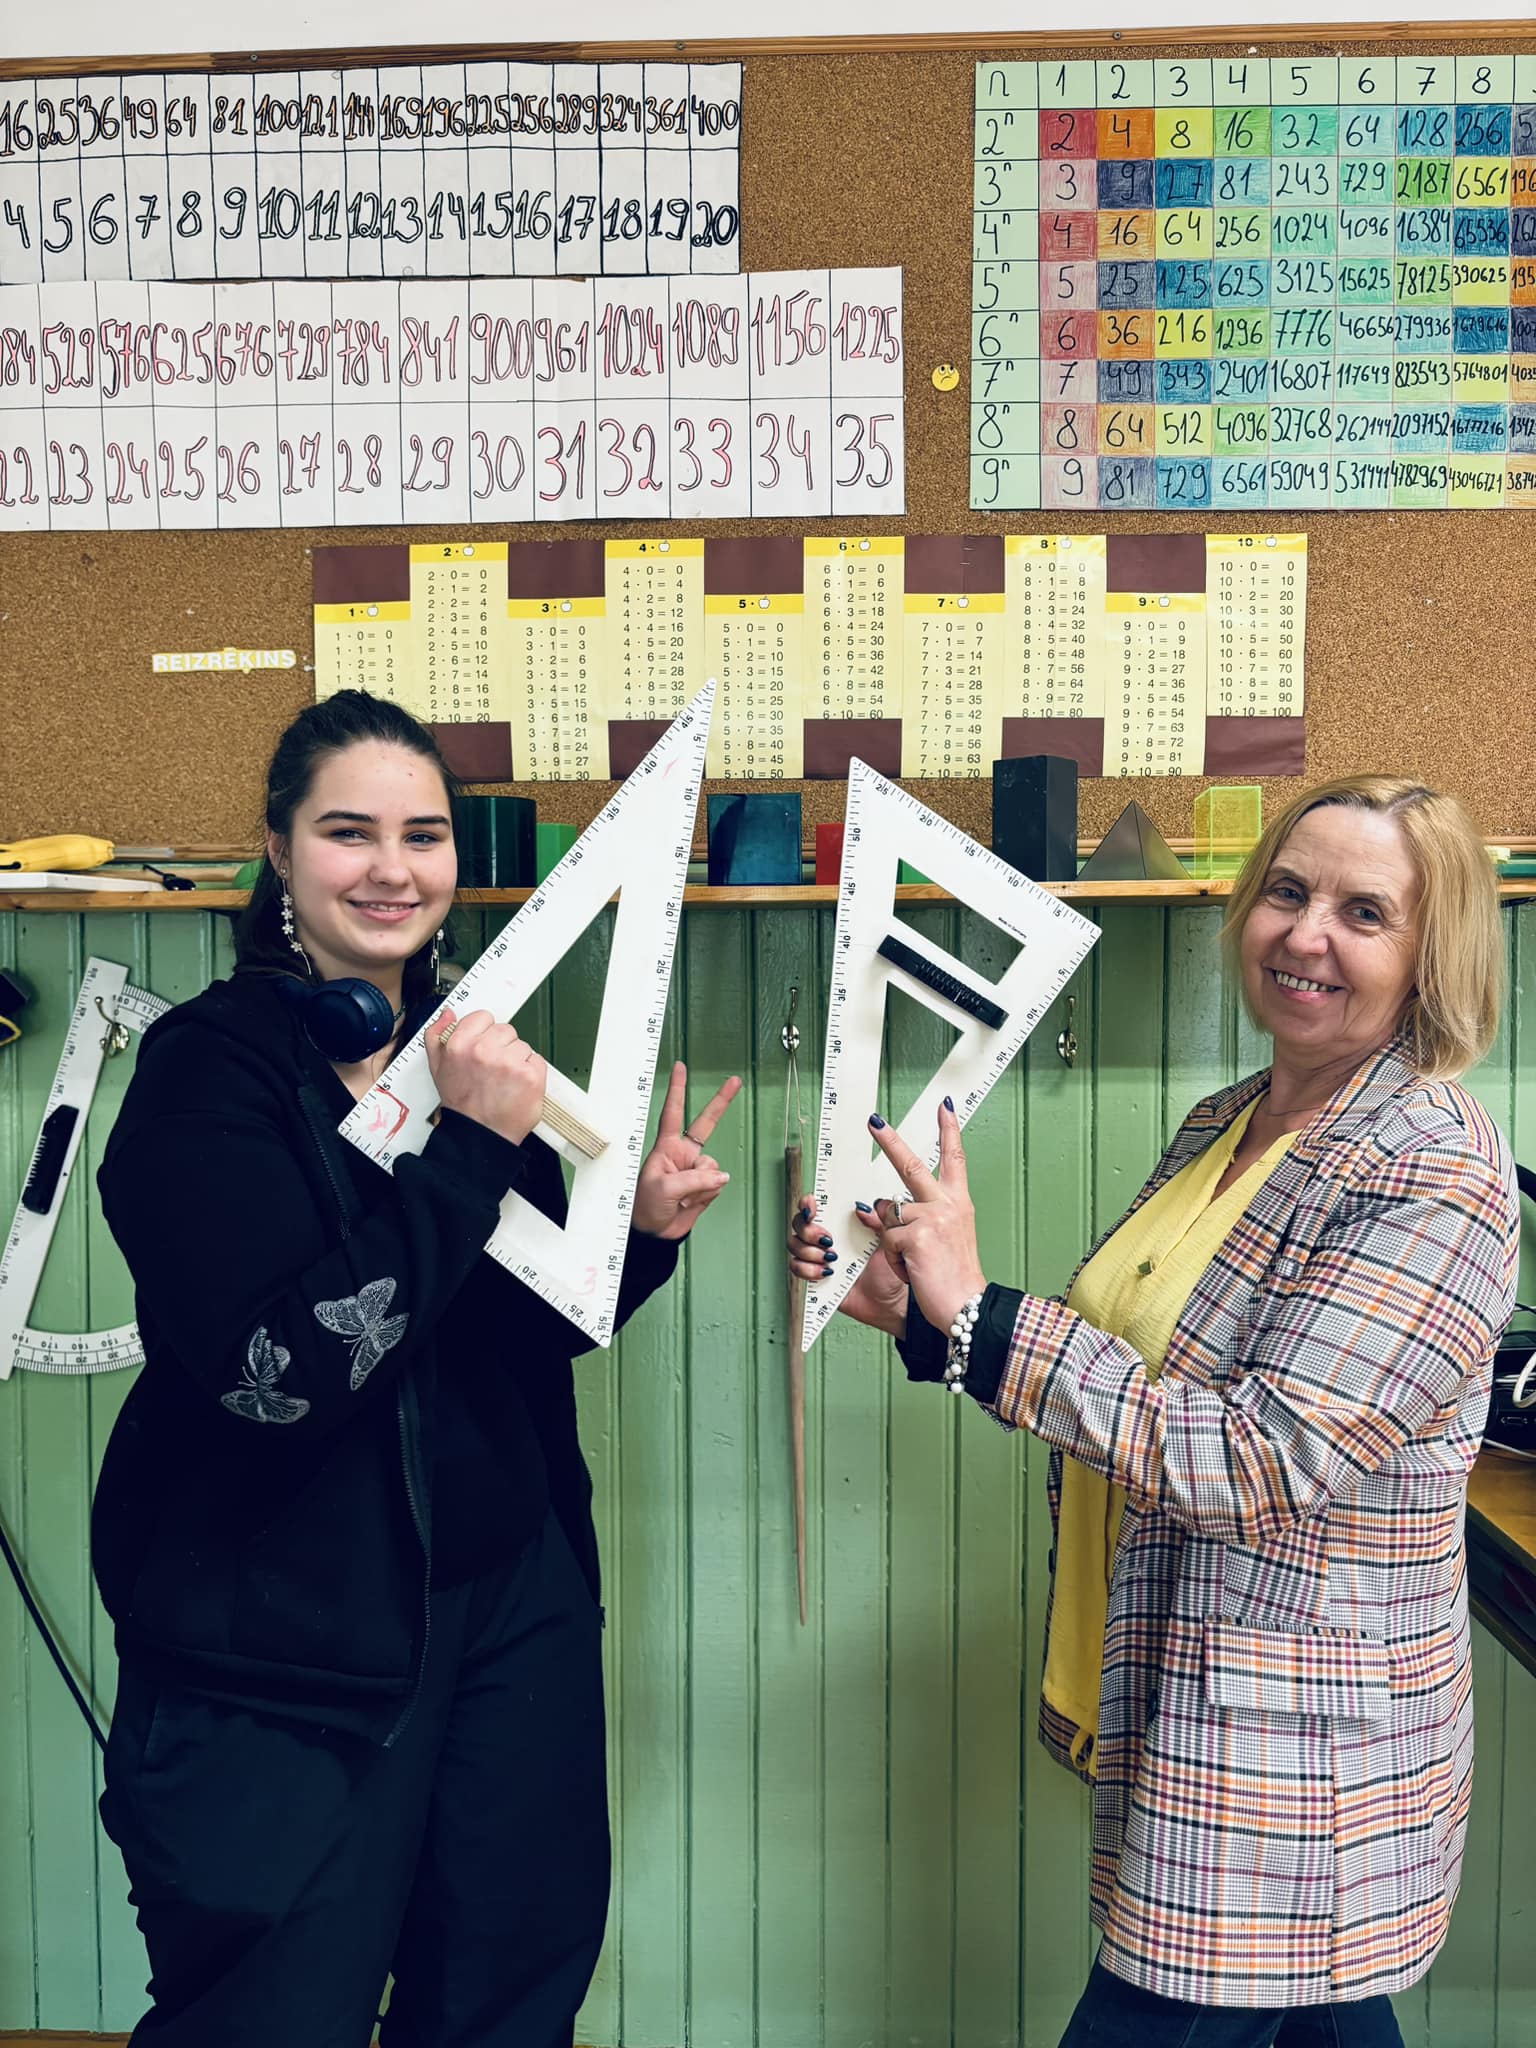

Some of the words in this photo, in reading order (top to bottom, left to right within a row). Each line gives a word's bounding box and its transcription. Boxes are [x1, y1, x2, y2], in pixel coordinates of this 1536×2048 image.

[989, 70, 1010, 97] n
[1055, 64, 1066, 96] 1
[1111, 64, 1131, 99] 2
[1170, 66, 1189, 97] 3
[1228, 64, 1247, 94] 4
[1291, 66, 1312, 95] 5
[1358, 68, 1375, 94] 6
[1415, 67, 1436, 96] 7
[1472, 66, 1491, 94] 8
[0, 100, 33, 156] 16
[37, 98, 77, 149] 25
[79, 96, 119, 145] 36
[124, 96, 158, 138] 49
[166, 96, 197, 136] 64
[213, 96, 248, 135] 81
[255, 94, 300, 135] 100
[301, 95, 338, 136] 121
[344, 92, 374, 140] 144
[381, 96, 422, 140] 169
[423, 96, 464, 136] 196
[467, 94, 510, 135] 225
[511, 94, 553, 134] 256
[555, 95, 597, 134] 289
[601, 94, 640, 132] 324
[646, 97, 686, 134] 361
[692, 95, 738, 135] 400
[1050, 113, 1075, 151] 2
[1112, 114, 1130, 148] 4
[1170, 120, 1191, 148] 8
[1224, 111, 1253, 151] 16
[1280, 113, 1321, 148] 32
[1346, 115, 1380, 147] 64
[1398, 109, 1448, 147] 128
[1056, 163, 1077, 200] 3
[1121, 162, 1136, 200] 9
[1164, 164, 1204, 200] 27
[1220, 163, 1252, 200] 81
[1276, 162, 1330, 197] 243
[1343, 163, 1386, 193] 729
[1398, 163, 1450, 198] 2187
[1456, 166, 1508, 200] 6561
[5, 200, 30, 248] 4
[44, 199, 72, 253] 5
[89, 194, 118, 244] 6
[136, 195, 160, 238] 7
[177, 191, 201, 238] 8
[220, 187, 247, 238] 9
[259, 187, 300, 238] 10
[306, 190, 340, 239] 11
[348, 192, 381, 238] 12
[381, 197, 422, 243] 13
[428, 192, 465, 239] 14
[471, 192, 512, 238] 15
[515, 190, 551, 238] 16
[559, 196, 596, 242] 17
[602, 199, 641, 241] 18
[650, 198, 689, 240] 19
[692, 202, 737, 246] 20
[1053, 215, 1071, 249] 4
[1110, 215, 1140, 245] 16
[1164, 211, 1201, 246] 64
[1215, 215, 1261, 247] 256
[1273, 213, 1328, 243] 1024
[1340, 209, 1390, 240] 4096
[1397, 208, 1450, 244] 16384
[1059, 265, 1074, 298] 5
[1103, 264, 1138, 297] 25
[1159, 265, 1208, 299] 125
[1219, 265, 1264, 297] 625
[1277, 259, 1333, 293] 3125
[1338, 265, 1390, 292] 15625
[1058, 317, 1076, 350] 6
[1107, 315, 1140, 345] 36
[1158, 312, 1206, 345] 216
[1216, 318, 1263, 350] 1296
[1274, 308, 1332, 348] 7776
[1339, 312, 1393, 339] 46656
[0, 328, 35, 386] 84
[43, 322, 94, 393] 529
[101, 319, 150, 398] 576
[152, 322, 213, 384] 625
[216, 322, 273, 385] 676
[278, 320, 330, 382] 729
[334, 319, 389, 386] 784
[401, 315, 459, 386] 841
[470, 313, 532, 384] 900
[535, 319, 589, 384] 961
[598, 303, 663, 378] 1024
[672, 300, 739, 367] 1089
[752, 290, 826, 376] 1156
[833, 303, 899, 363] 1225
[1059, 361, 1078, 395] 7
[1108, 361, 1141, 395] 49
[1163, 361, 1206, 390] 343
[1216, 360, 1269, 396] 2401
[1271, 359, 1332, 393] 16807
[1056, 409, 1077, 448] 8
[1106, 411, 1143, 447] 64
[1164, 411, 1203, 444] 512
[1217, 408, 1267, 445] 4096
[1271, 407, 1332, 442] 32768
[51, 441, 93, 504] 23
[107, 442, 150, 504] 24
[160, 436, 208, 500] 25
[218, 441, 260, 503] 26
[280, 432, 321, 495] 27
[338, 435, 382, 493] 28
[402, 434, 453, 491] 29
[471, 430, 525, 499] 30
[538, 420, 586, 500] 31
[599, 419, 662, 496] 32
[674, 418, 732, 492] 33
[756, 413, 814, 491] 34
[837, 413, 894, 490] 35
[1062, 459, 1083, 495] 9
[1105, 466, 1134, 500] 81
[1164, 464, 1207, 500] 729
[1222, 462, 1267, 493] 6561
[1271, 460, 1328, 490] 59049
[824, 621, 831, 631] 6
[847, 622, 853, 631] 4
[870, 621, 884, 631] 24
[429, 656, 436, 666] 2
[451, 655, 458, 665] 6
[475, 654, 488, 664] 12
[1220, 663, 1232, 673] 10
[1249, 663, 1255, 673] 7
[1279, 664, 1292, 673] 70
[681, 715, 694, 729] 45
[644, 760, 657, 775] 40
[684, 788, 692, 801] 10
[875, 783, 889, 796] 25
[606, 806, 620, 821] 35
[920, 814, 933, 827] 20
[852, 827, 861, 842] 50
[569, 851, 583, 866] 30
[532, 897, 545, 912] 25
[494, 943, 508, 958] 20
[656, 960, 666, 975] 25
[637, 1076, 647, 1091] 35
[617, 1195, 628, 1210] 45
[607, 1255, 617, 1271] 50
